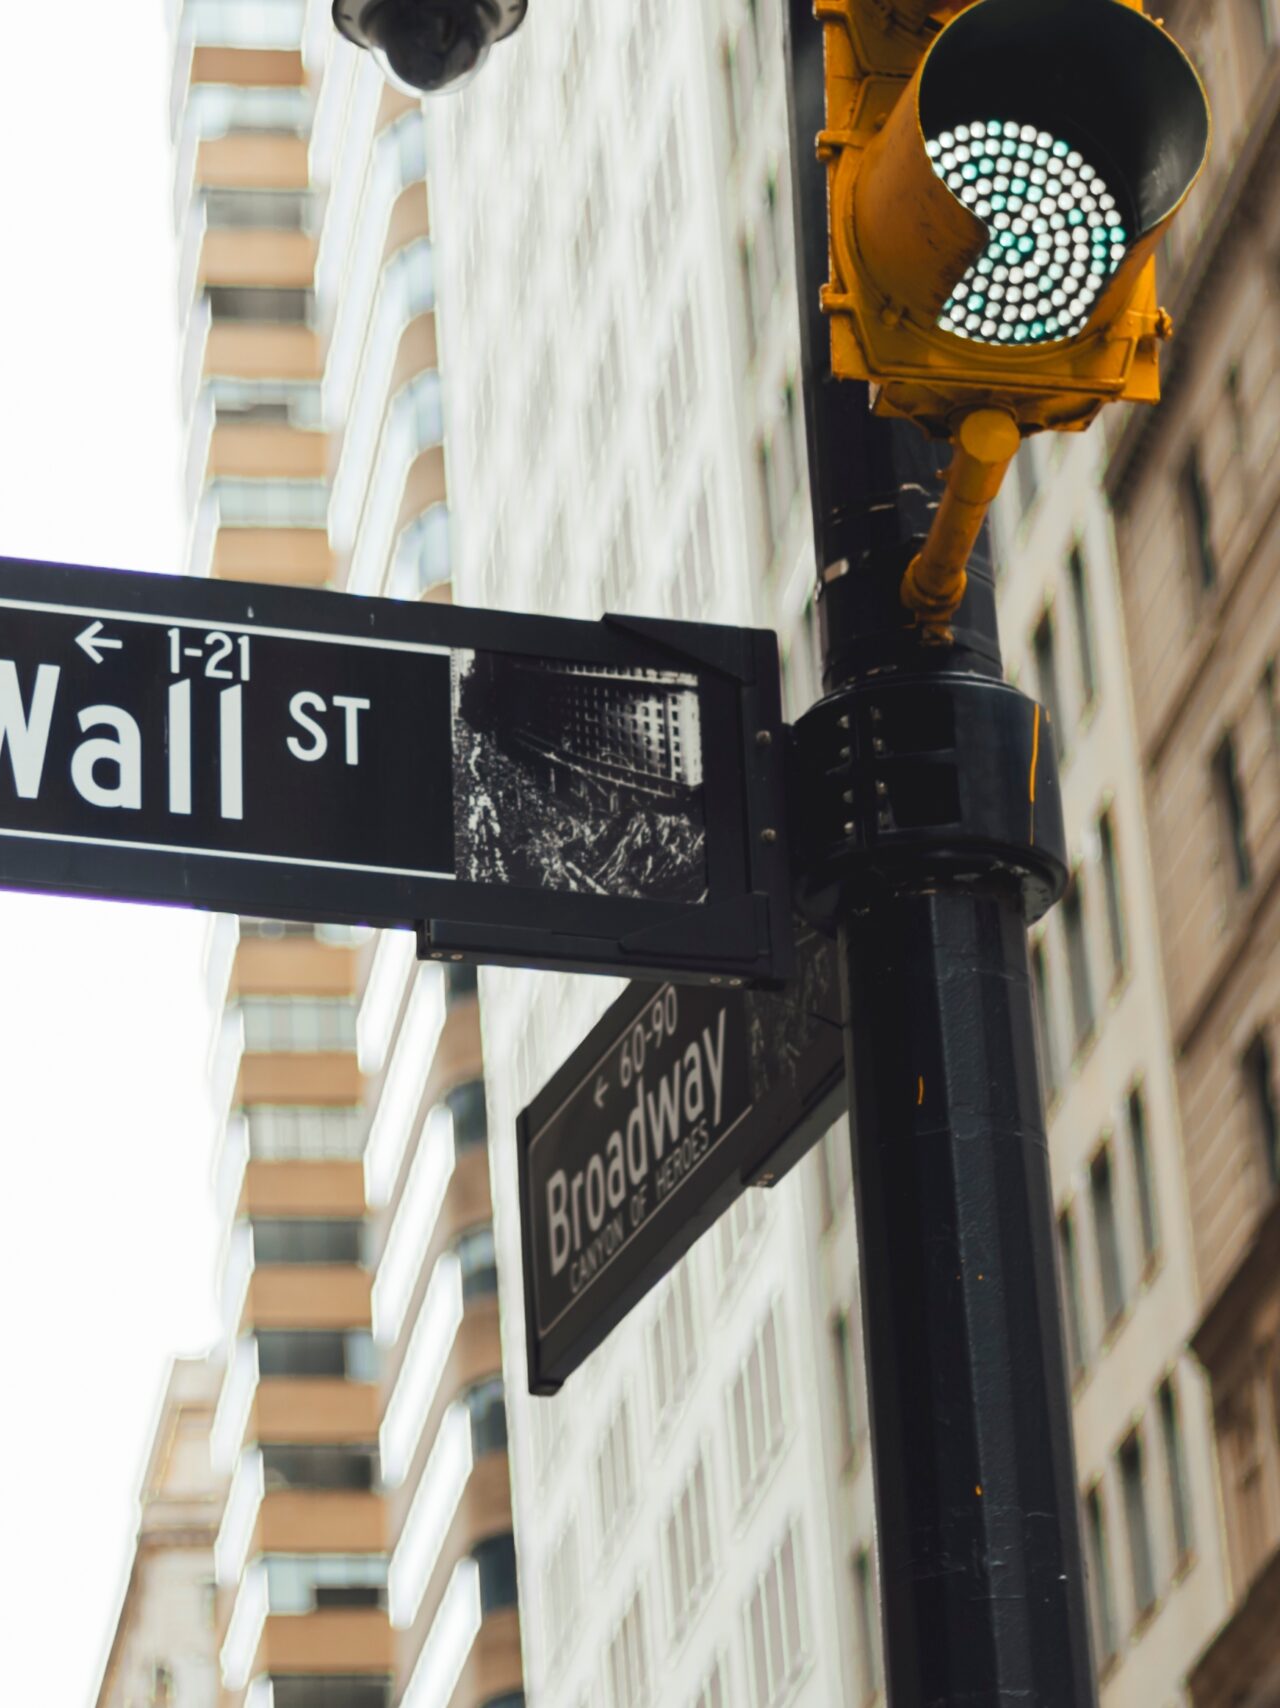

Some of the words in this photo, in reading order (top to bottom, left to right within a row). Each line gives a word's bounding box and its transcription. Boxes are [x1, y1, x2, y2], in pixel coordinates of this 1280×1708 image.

[168, 628, 250, 681] 1-21
[286, 691, 370, 765] ST
[620, 986, 677, 1088] 60-90
[547, 1008, 726, 1277] Broadway
[571, 1213, 623, 1293] CANYON
[630, 1184, 647, 1227] OF
[656, 1118, 709, 1198] HEROES
